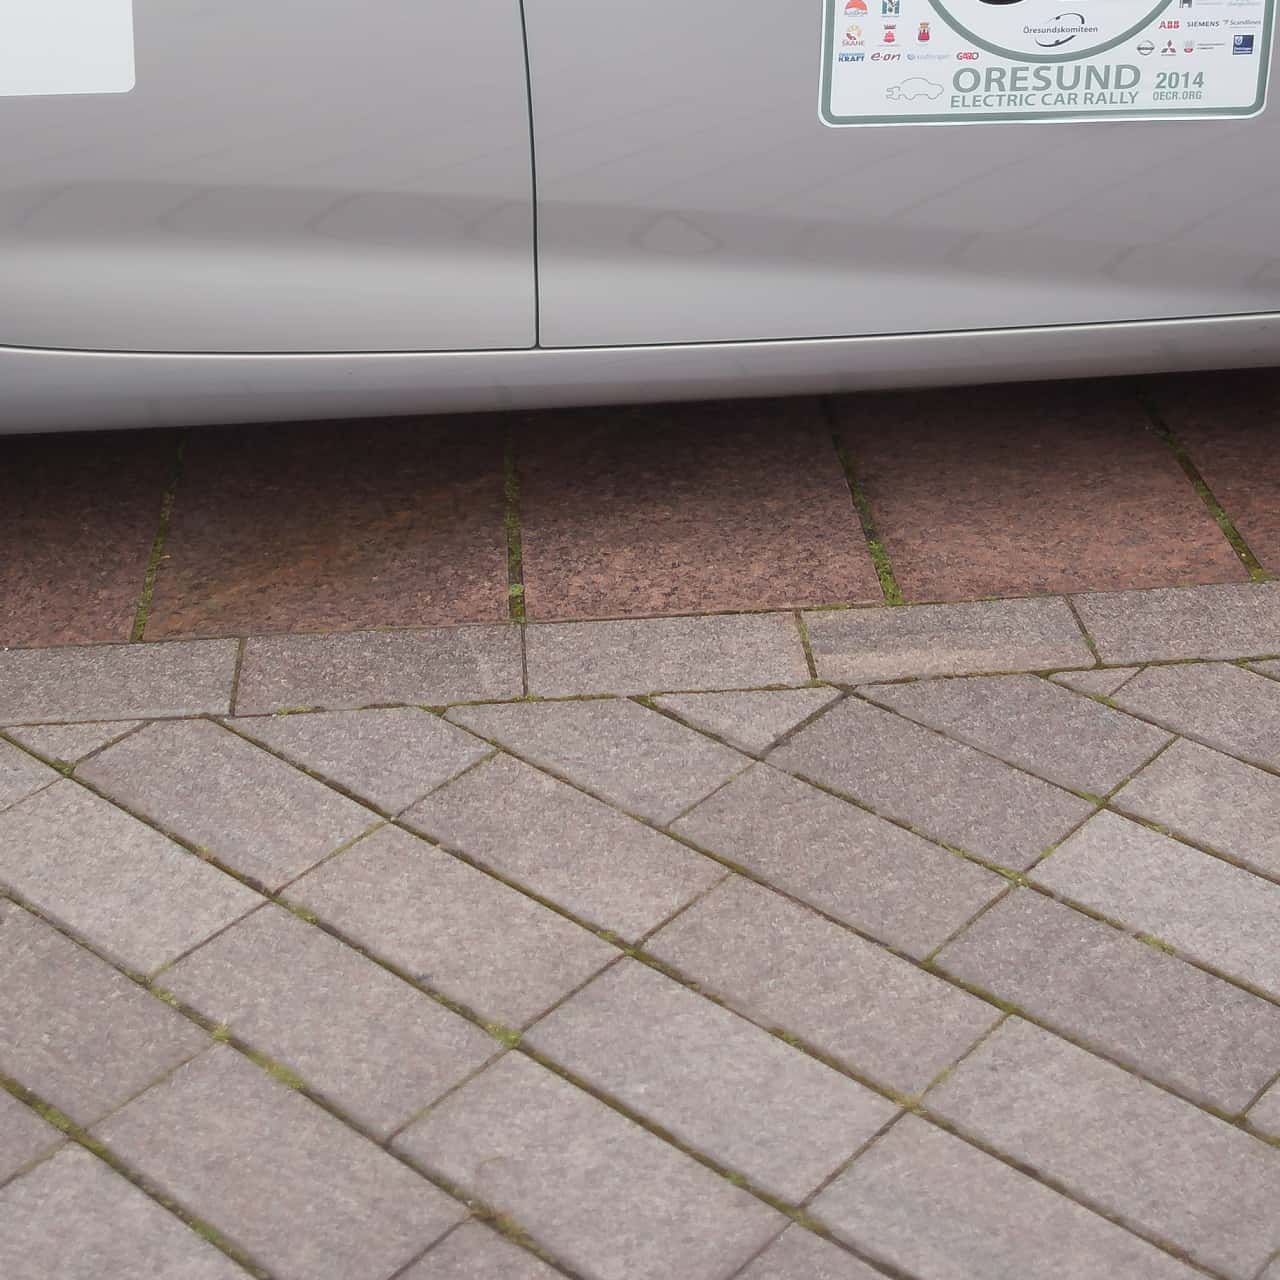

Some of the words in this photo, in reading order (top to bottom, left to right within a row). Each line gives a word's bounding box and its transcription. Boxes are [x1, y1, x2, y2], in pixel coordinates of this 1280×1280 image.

[1023, 24, 1099, 34] Öresundskomiteen
[1159, 20, 1180, 29] ABB
[952, 64, 1141, 93] ORESUND
[1155, 72, 1204, 89] 2014
[951, 93, 1036, 108] ELECTRIC
[1041, 92, 1078, 106] CAR
[1083, 91, 1139, 105] RALLY
